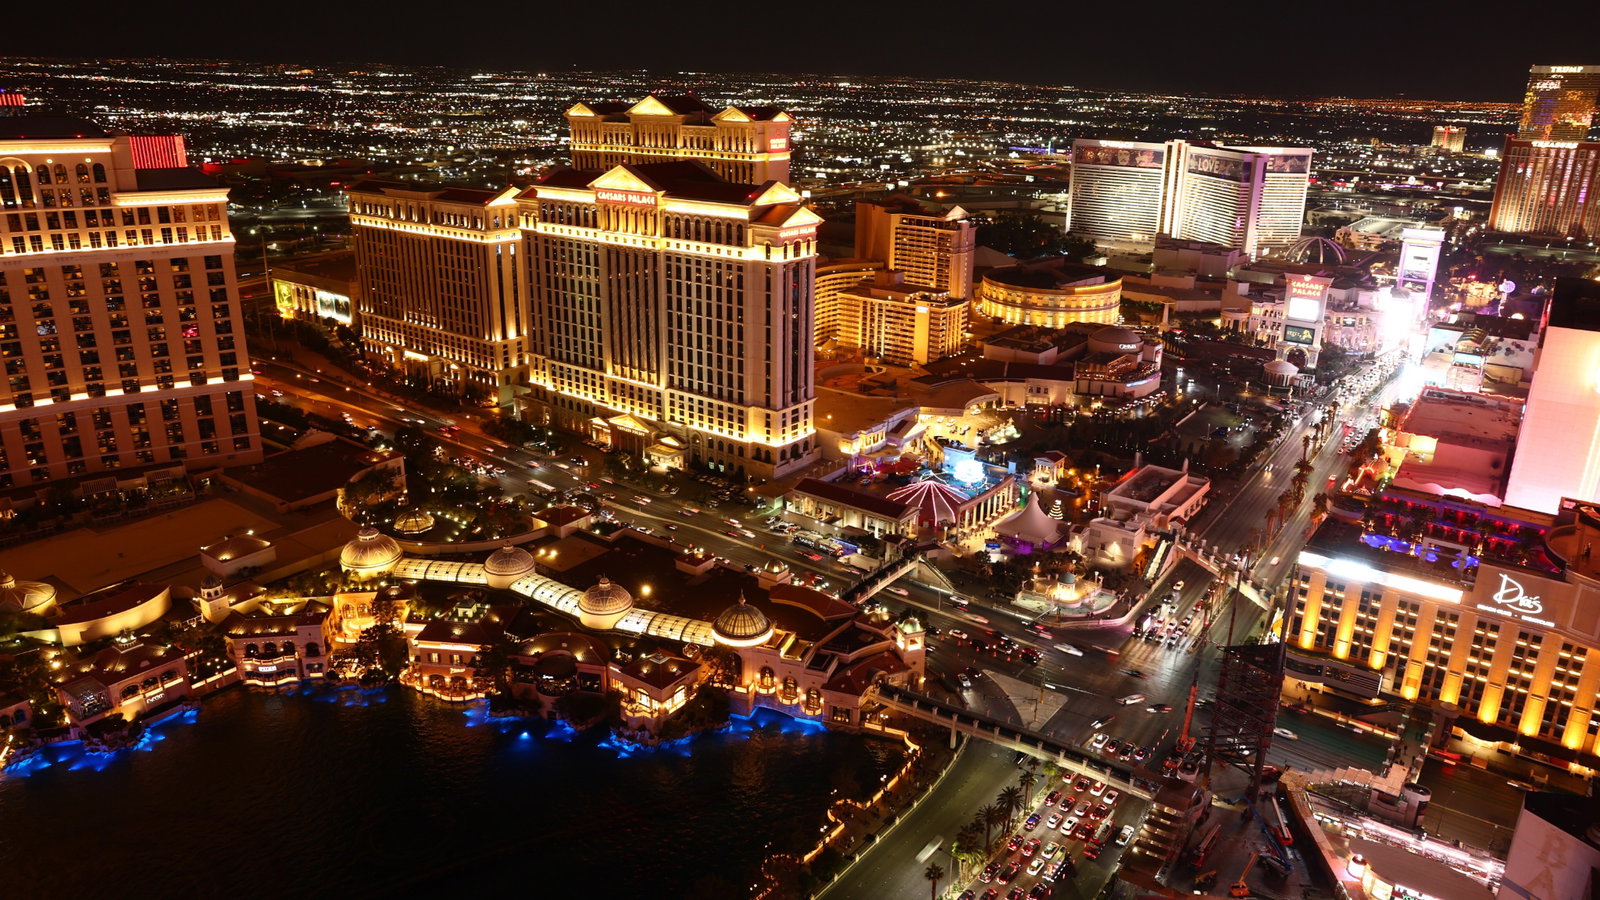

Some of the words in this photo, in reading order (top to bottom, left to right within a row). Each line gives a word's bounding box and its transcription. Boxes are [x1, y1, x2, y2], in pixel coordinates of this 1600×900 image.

[1198, 158, 1220, 173] LOVE
[597, 192, 626, 202] CAESARS
[628, 194, 655, 205] PALACE
[1292, 281, 1324, 290] CAESARS
[1292, 288, 1321, 296] PALACE
